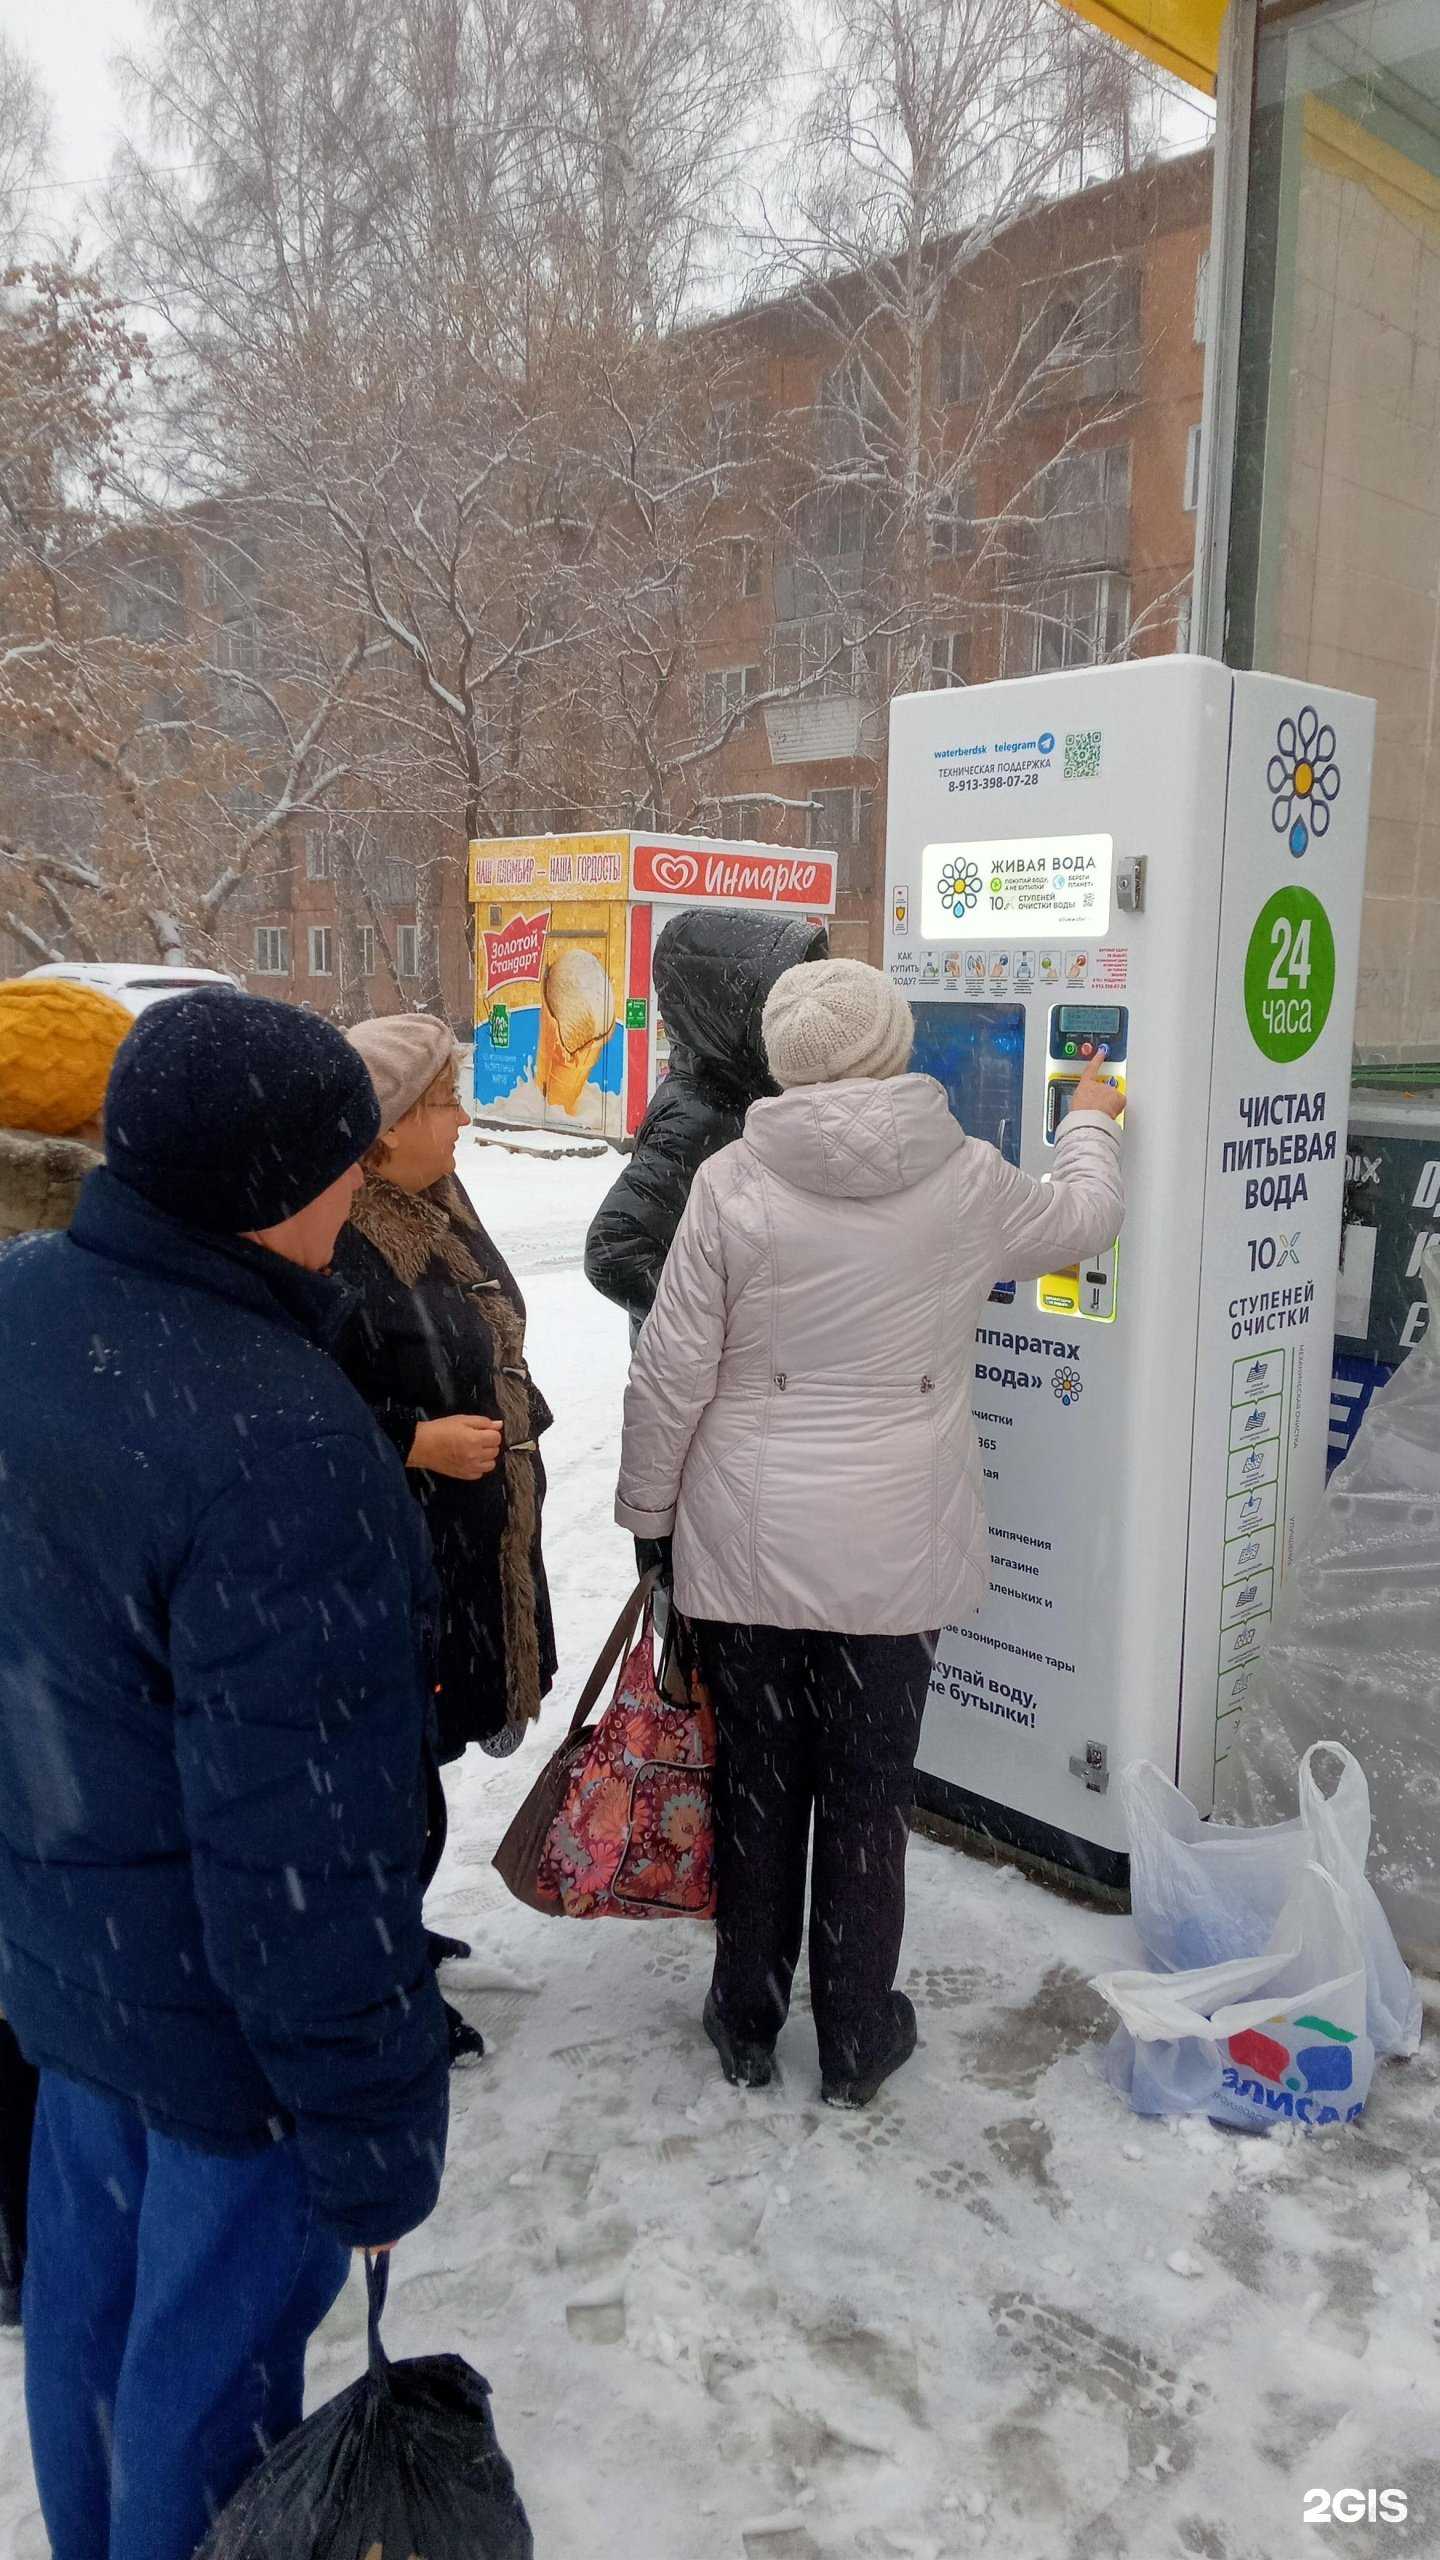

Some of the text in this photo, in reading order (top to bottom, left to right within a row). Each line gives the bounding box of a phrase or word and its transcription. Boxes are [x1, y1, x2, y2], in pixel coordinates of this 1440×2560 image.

[934, 739, 1037, 759] waterberdsk telegram
[938, 758, 1051, 778] ТЕХНИЧЕСКАЯ ПОДДЕРЖКА
[949, 774, 1039, 792] 8-913-398-07-28
[476, 859, 493, 884] НАШ
[550, 856, 572, 882] НАША
[577, 855, 621, 881] ГОРДОСТЬ!
[704, 856, 817, 903] Инмарко
[991, 856, 1096, 874] ЖИВАЯ ВОДА
[1018, 892, 1056, 902] СТУПЕНЕЙ
[1018, 901, 1076, 910] ОЧИСТКИ ВОДЫ
[491, 928, 538, 959] Золотой
[897, 951, 913, 961] КАК
[1267, 917, 1312, 990] 24
[490, 952, 538, 975] Стандарт
[890, 964, 920, 973] КУПИТЬ
[1262, 999, 1312, 1034] часа
[1239, 1092, 1326, 1128] ЧИСТАЯ
[1221, 1130, 1337, 1173] ПИТЬЕВАЯ
[1244, 1172, 1309, 1212] ВОДА
[1228, 1279, 1314, 1319] СТУПЕНЕЙ
[1231, 1306, 1310, 1340] ОЧИСТКИ
[974, 1363, 1043, 1389] вода»
[987, 1525, 1052, 1551] кипячения
[1044, 1599, 1053, 1609] и
[942, 1623, 1076, 1673] ое озонирование тары
[949, 1683, 1035, 1729] бутылки!
[988, 1679, 1038, 1709] воду,
